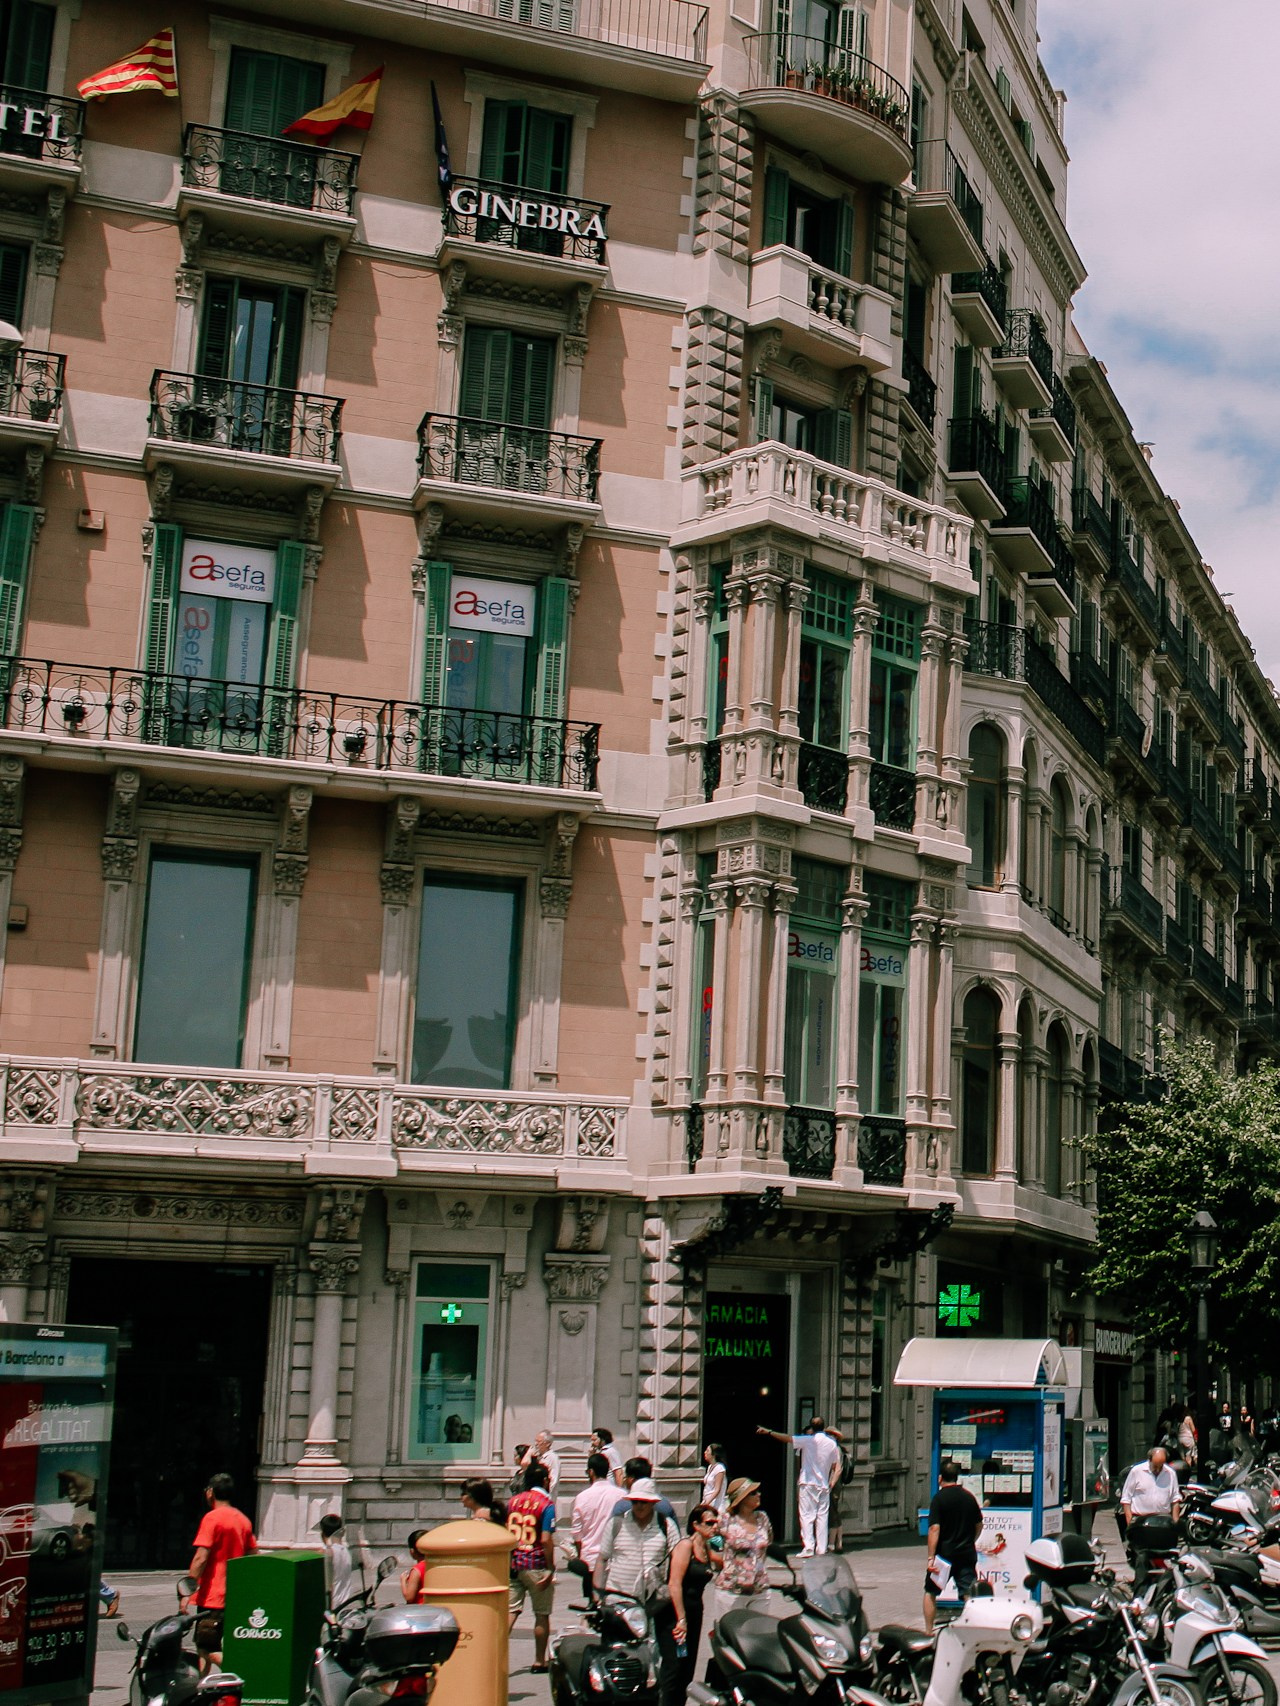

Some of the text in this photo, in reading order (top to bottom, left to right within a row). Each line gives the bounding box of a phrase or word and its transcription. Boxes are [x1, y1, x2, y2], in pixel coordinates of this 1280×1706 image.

[450, 188, 607, 240] GINEBRA
[189, 555, 265, 586] asefa
[228, 581, 266, 592] seguros
[454, 591, 525, 620] asefa
[491, 616, 526, 626] seguros
[182, 607, 210, 677] asefa
[788, 932, 834, 962] asefa
[860, 947, 903, 975] asefa
[1095, 1328, 1136, 1356] BURGER KIN
[5, 1350, 55, 1366] Barcelona
[15, 1418, 91, 1442] REGALITAT
[508, 1511, 538, 1546] 66
[982, 1523, 1006, 1531] ODEM
[979, 1571, 1011, 1583] NTS
[60, 1631, 72, 1647] 30
